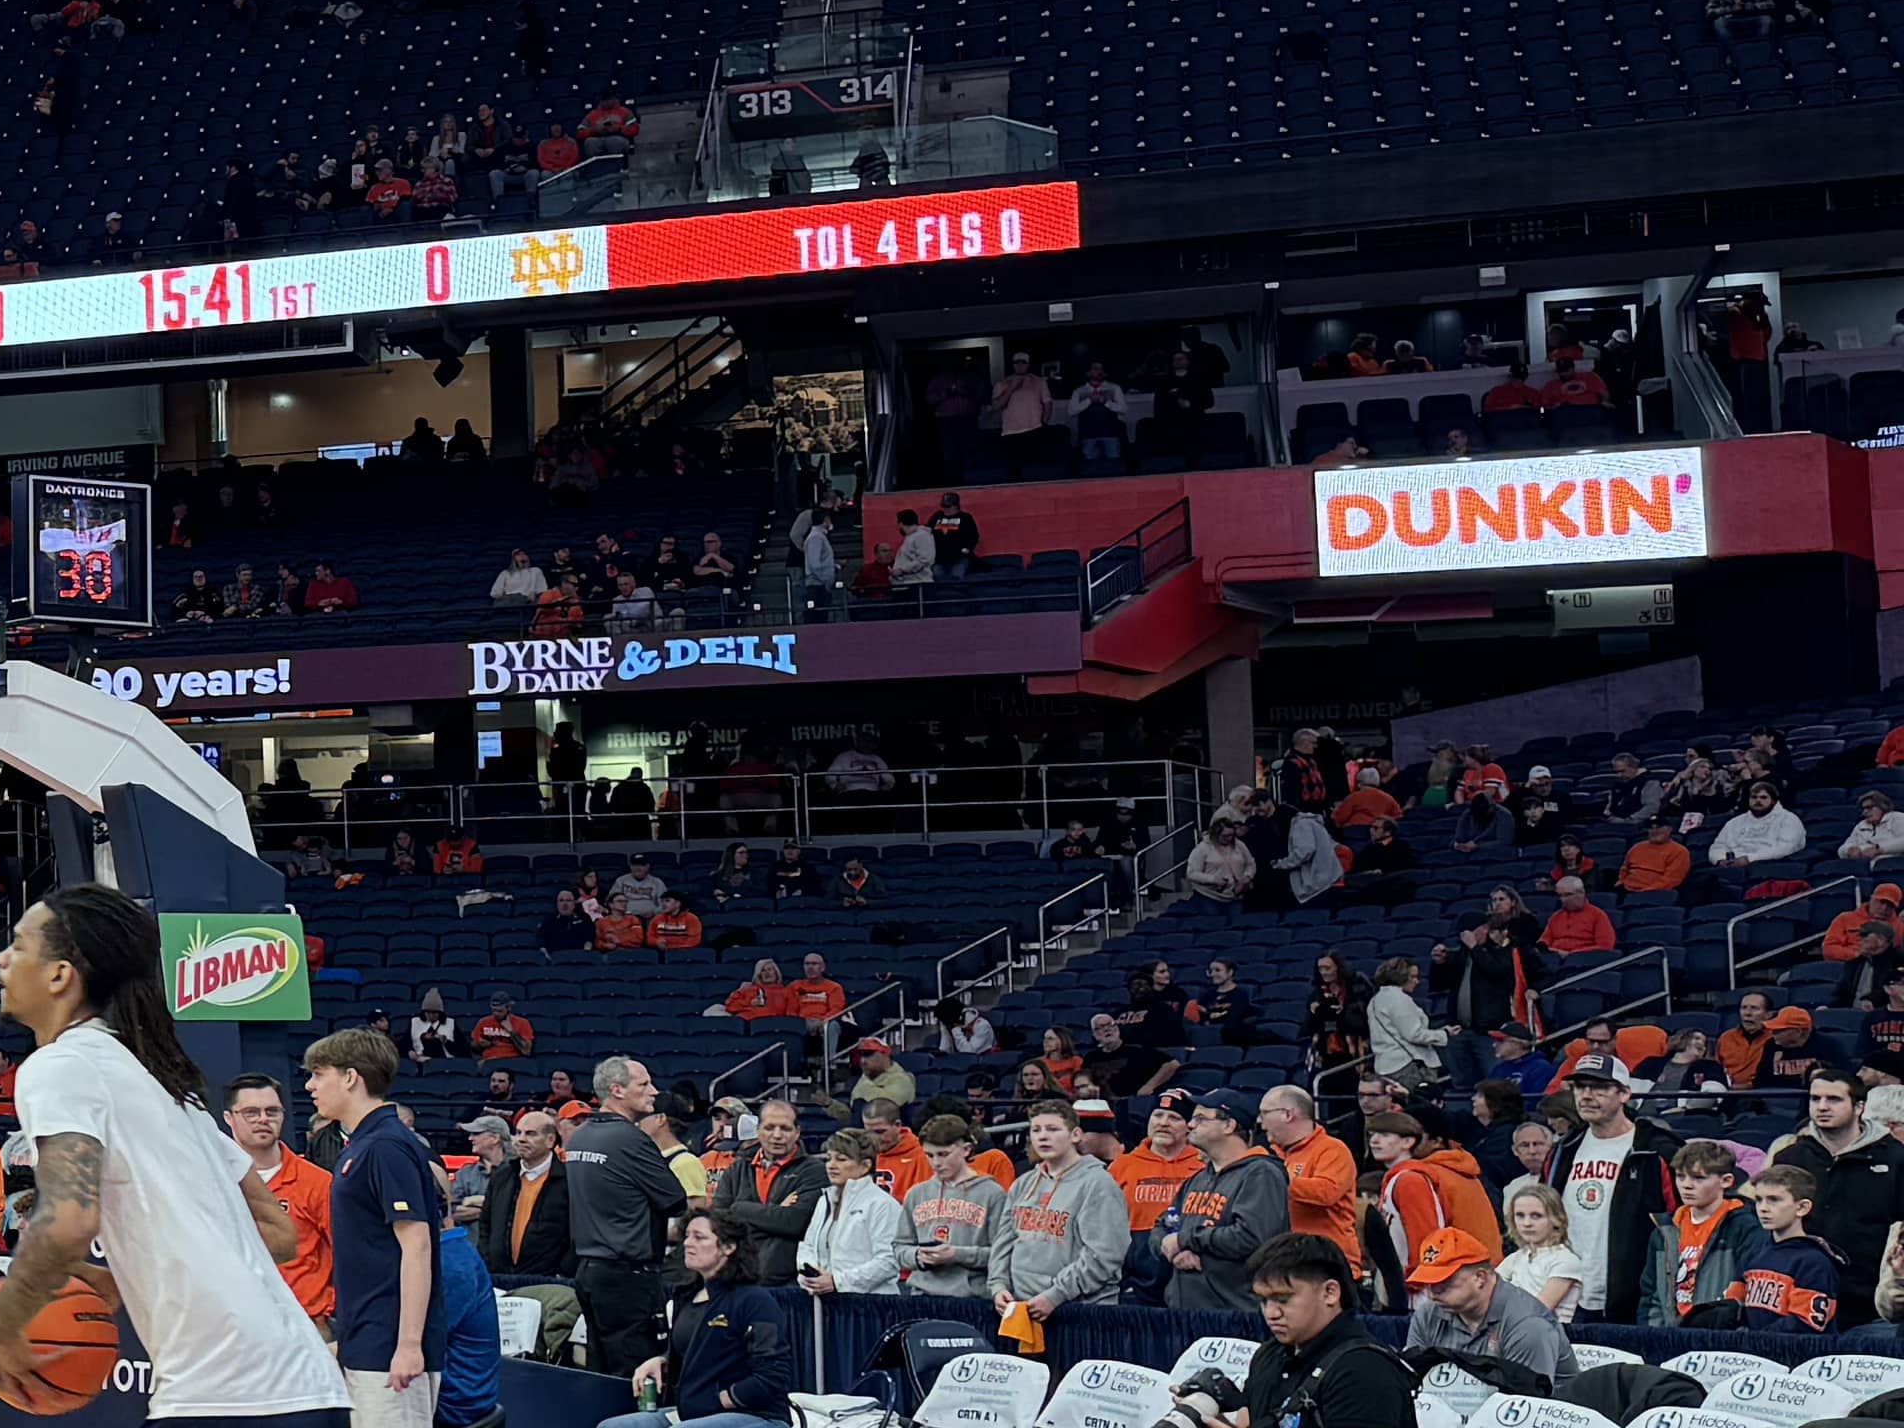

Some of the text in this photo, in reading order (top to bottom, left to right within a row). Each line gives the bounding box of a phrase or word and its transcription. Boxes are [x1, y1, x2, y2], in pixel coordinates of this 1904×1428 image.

[838, 71, 896, 105] 314
[737, 88, 792, 121] 313
[794, 207, 1022, 270] TOL 4 FLS 0
[424, 244, 452, 303] 0
[138, 263, 317, 333] 15:41 1ST
[6, 450, 125, 474] IRVING AVENUE
[45, 483, 126, 500] DAKTRONICS
[1326, 472, 1693, 551] DUNKIN'
[467, 633, 798, 697] BYRNE & DELI
[153, 657, 293, 709] years!
[516, 670, 609, 694] DAIRY
[606, 730, 671, 750] IRVING
[175, 935, 287, 1012] LIBMAN
[982, 1360, 1023, 1374] Hidden
[1713, 1353, 1763, 1370] Hidden
[980, 1371, 1010, 1384] Level
[1110, 1380, 1141, 1395] Level
[1114, 1367, 1157, 1387] Hidden
